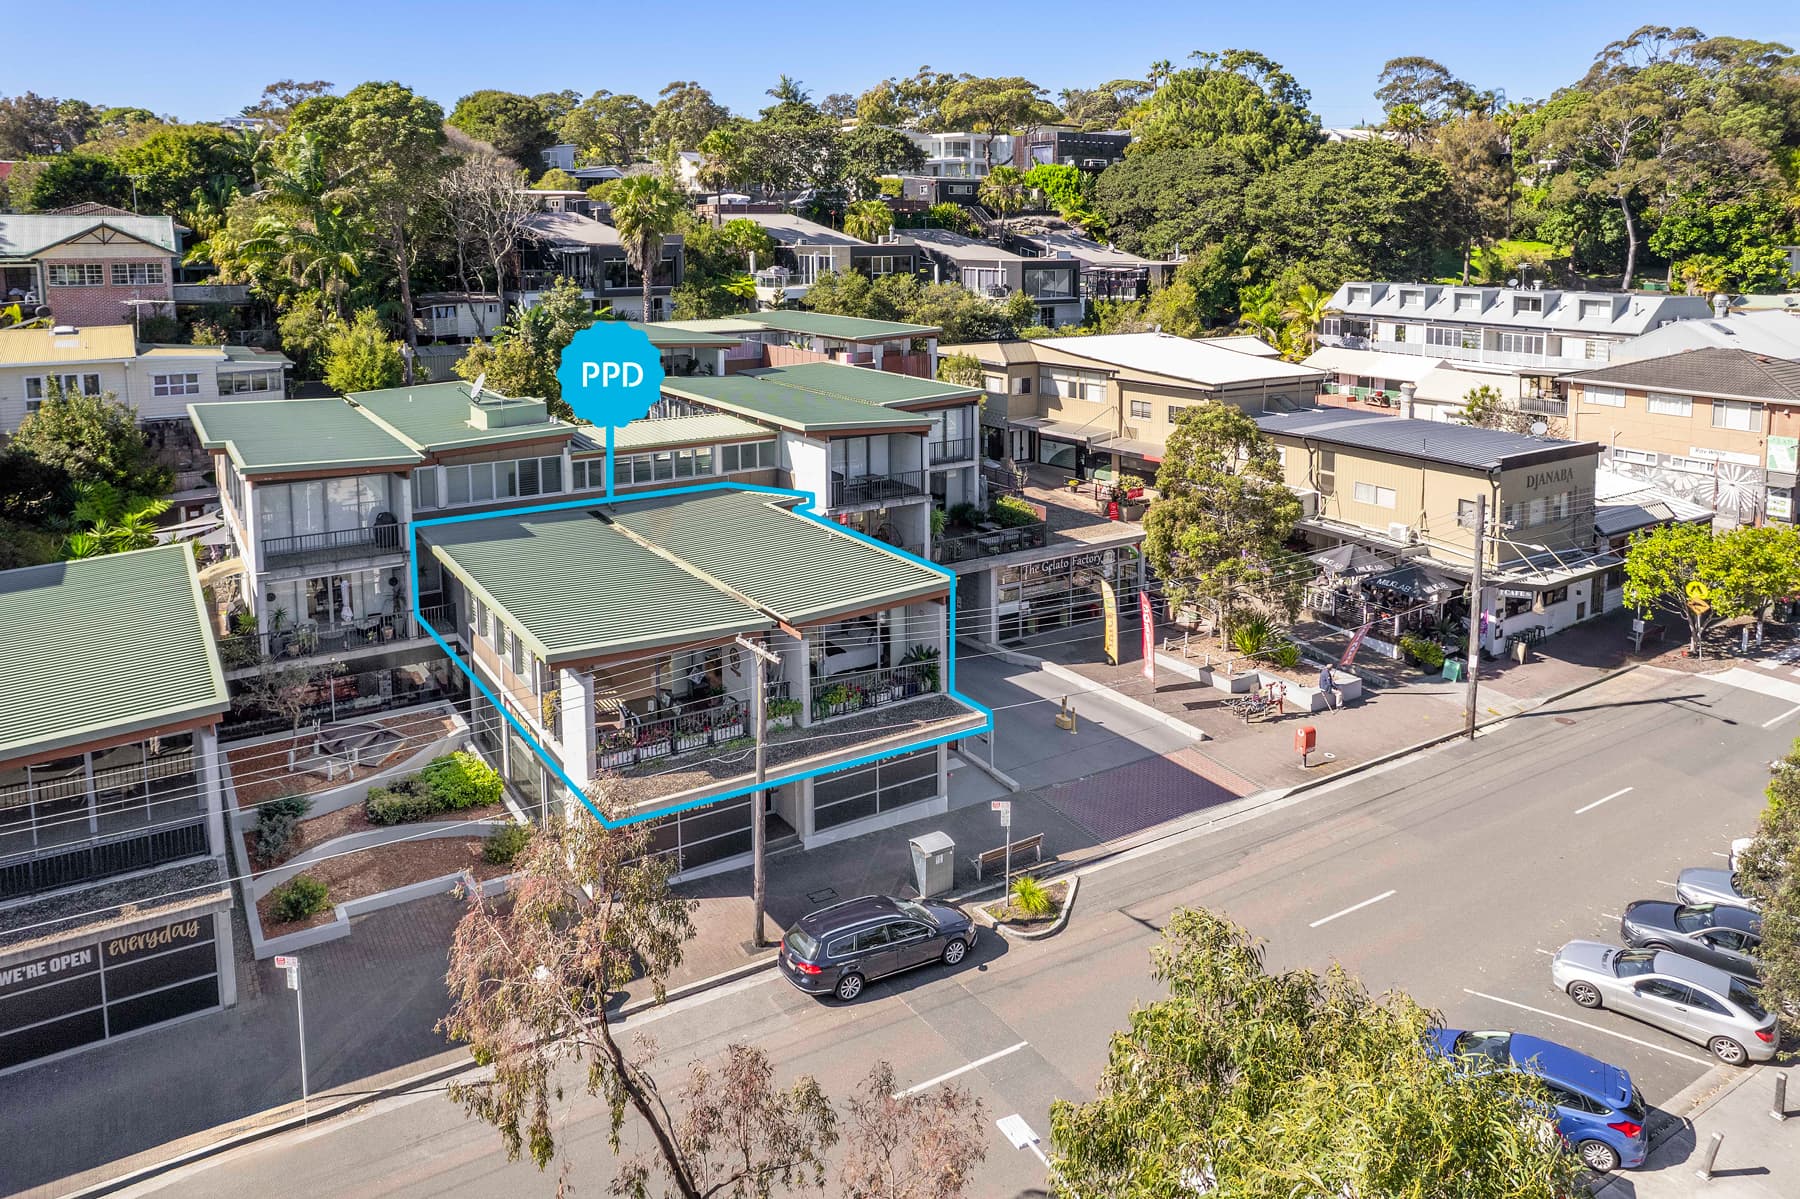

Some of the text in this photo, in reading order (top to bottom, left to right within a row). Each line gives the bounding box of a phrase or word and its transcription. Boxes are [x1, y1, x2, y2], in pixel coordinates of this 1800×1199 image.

[1526, 467, 1574, 491] DJANABA
[1022, 552, 1103, 580] The Gelato Factory
[1376, 578, 1412, 593] MILKLAB
[0, 919, 200, 987] WE'RE OPEN everyday
